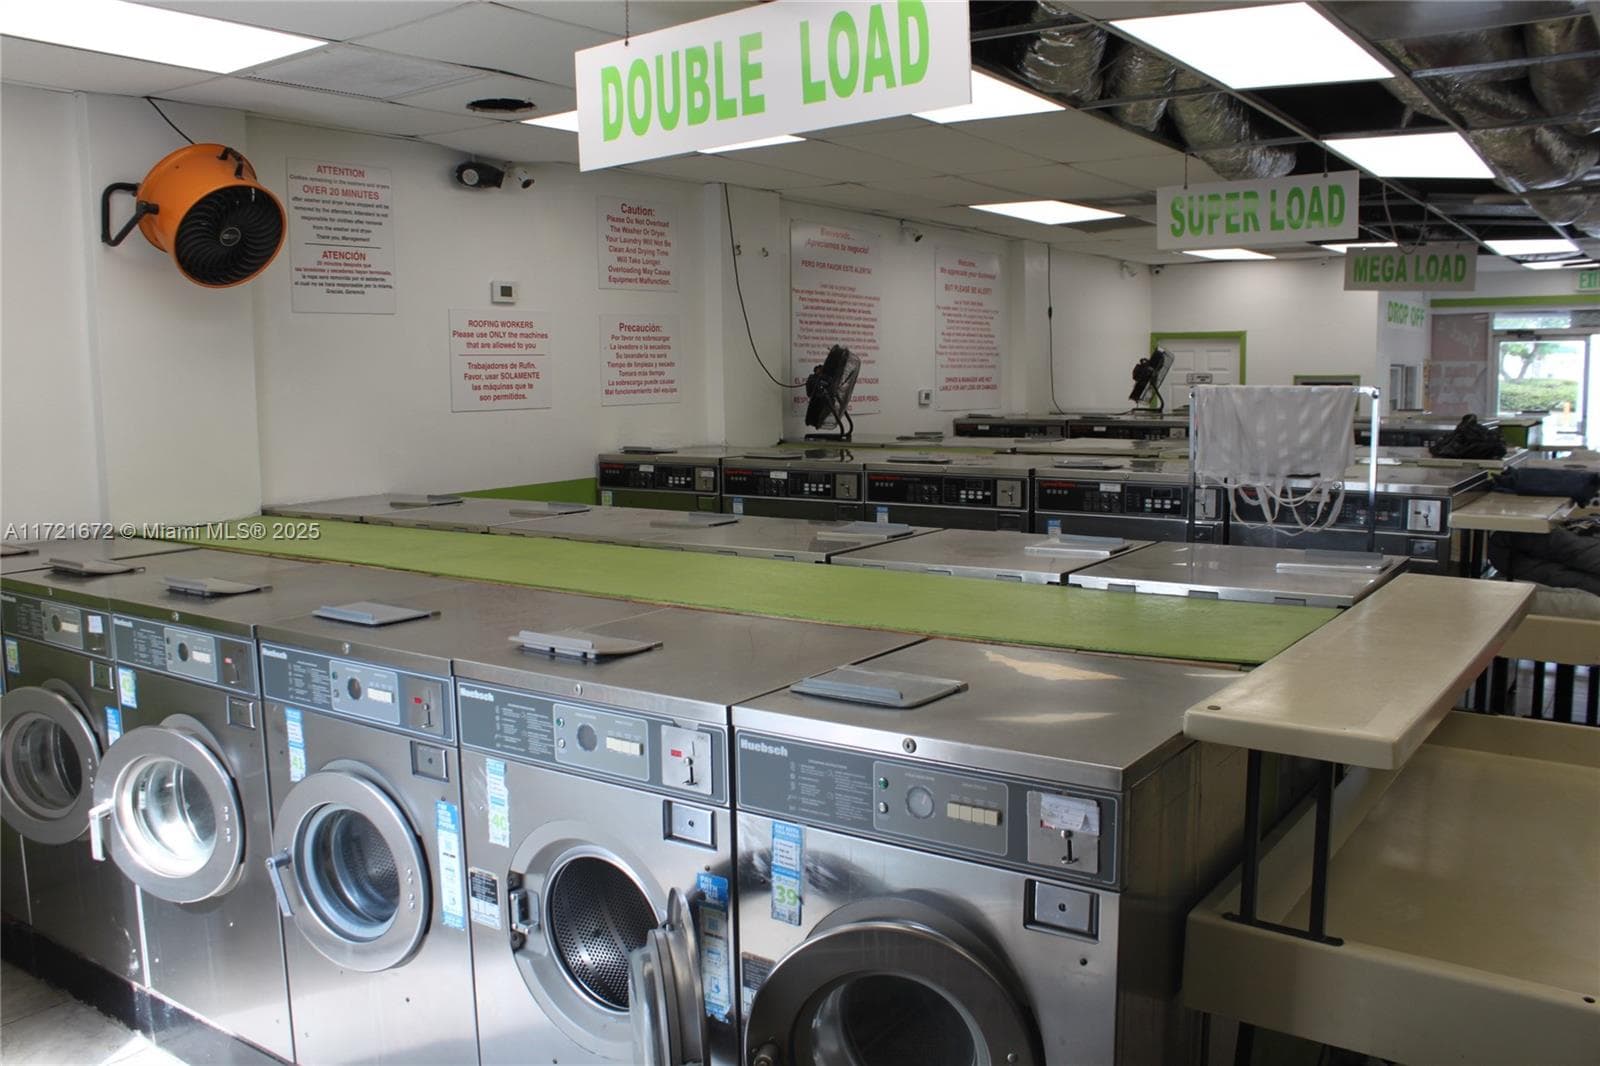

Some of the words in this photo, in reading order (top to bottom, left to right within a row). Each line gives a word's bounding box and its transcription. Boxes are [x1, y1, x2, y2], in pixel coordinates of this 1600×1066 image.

[600, 31, 766, 142] DOUBLE
[800, 0, 930, 105] LOAD
[317, 165, 366, 178] ATTENTION
[303, 184, 327, 195] OVER
[329, 187, 339, 196] 20
[341, 188, 379, 199] MINUTES
[621, 204, 654, 216] Caution:
[1170, 191, 1261, 237] SUPER
[1270, 184, 1345, 231] LOAD
[607, 215, 624, 223] Please
[625, 216, 633, 224] Do
[645, 219, 669, 228] Overload
[622, 226, 641, 234] Washer
[664, 239, 671, 247] Be
[637, 247, 655, 256] Drying
[656, 248, 668, 256] Time
[628, 256, 640, 264] Take
[815, 261, 826, 269] POR
[608, 265, 641, 274] Overloading
[642, 267, 653, 275] May
[1353, 254, 1408, 283] MEGA
[1414, 254, 1467, 283] LOAD
[1387, 300, 1409, 325] DROP
[1411, 305, 1425, 327] OFF
[500, 320, 533, 328] WORKERS
[619, 323, 662, 332] Precaución:
[500, 371, 539, 379] SOLAMENTE
[740, 738, 788, 757] Huebsch
[776, 884, 797, 907] 39
